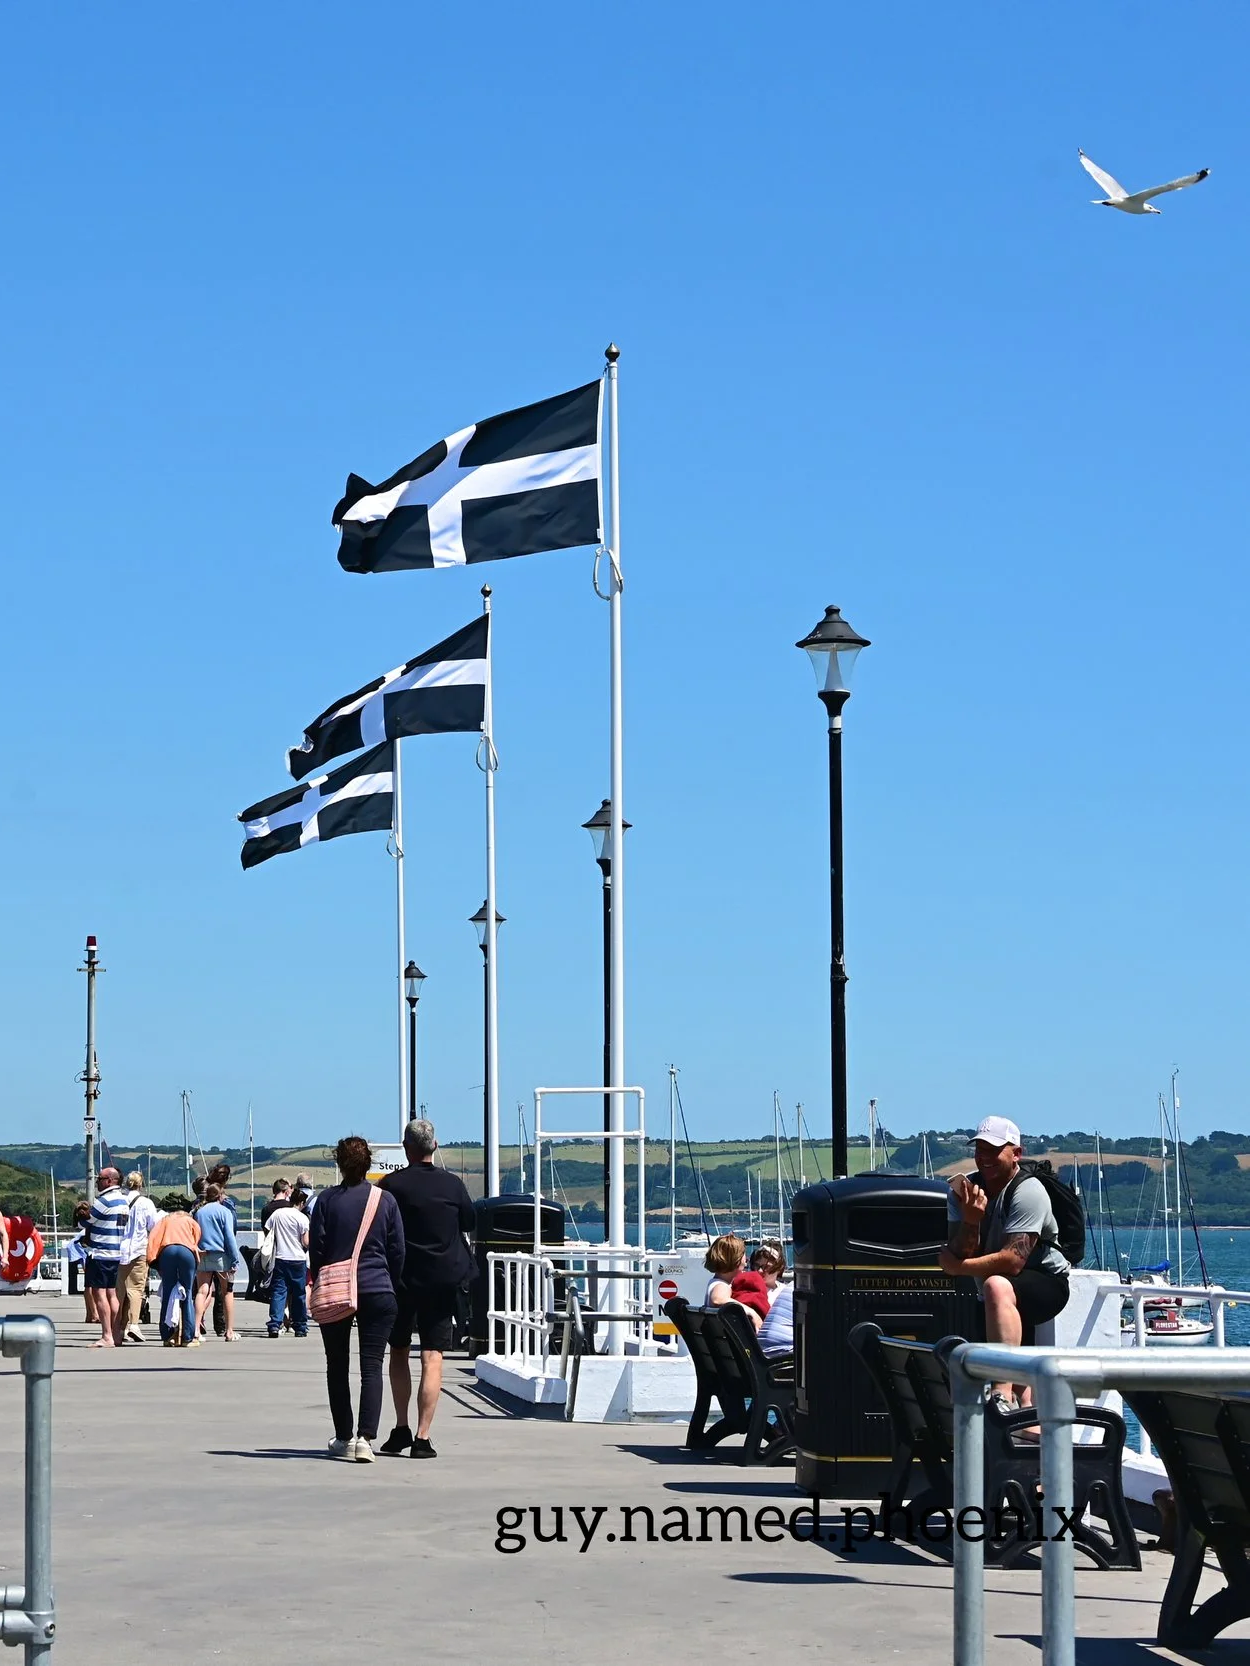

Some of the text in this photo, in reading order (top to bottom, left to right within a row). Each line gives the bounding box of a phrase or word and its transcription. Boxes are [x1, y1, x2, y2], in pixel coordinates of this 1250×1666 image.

[379, 1162, 404, 1171] Steps
[854, 1278, 890, 1288] LITTER
[896, 1278, 918, 1288] DOG
[919, 1278, 952, 1288] WASTE
